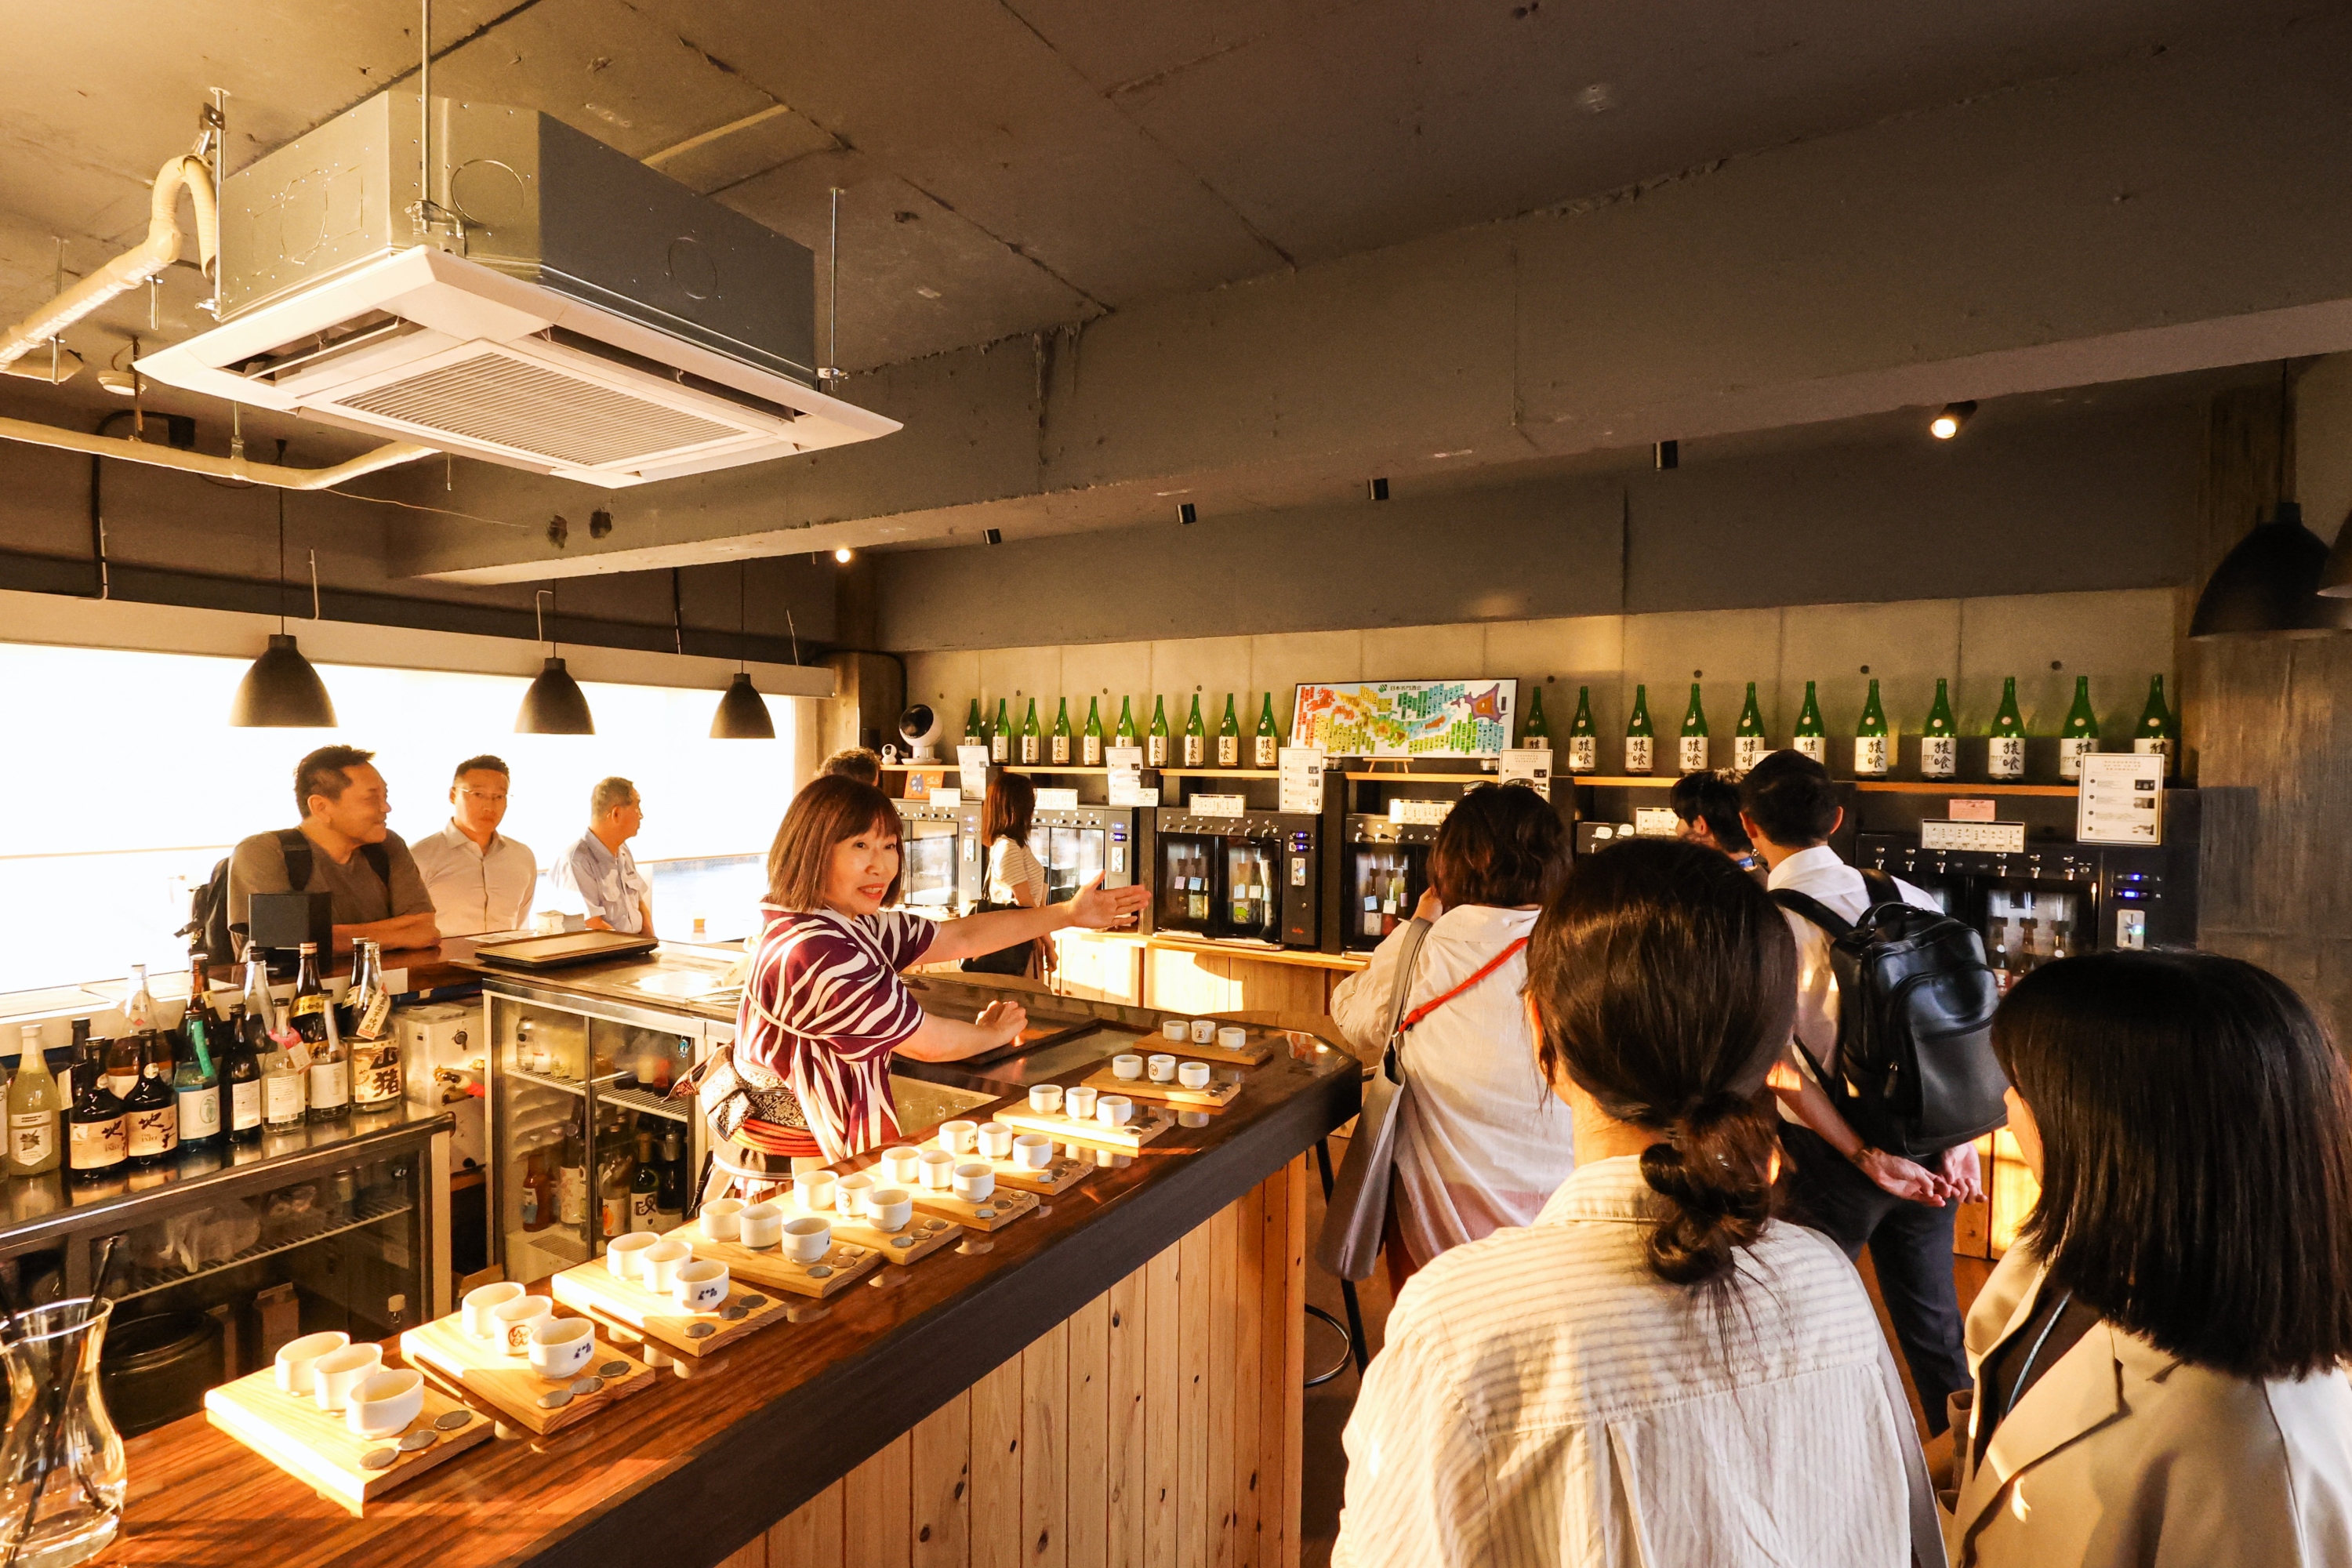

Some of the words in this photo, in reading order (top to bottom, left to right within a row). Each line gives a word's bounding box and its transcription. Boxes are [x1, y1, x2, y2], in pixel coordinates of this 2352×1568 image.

[1578, 739, 1592, 764] 猿喰
[1633, 739, 1648, 765] 猿喰
[1687, 739, 1702, 766] 猿喰
[1868, 739, 1884, 768] 猿喰
[1934, 740, 1951, 769] 猿喰
[2003, 740, 2020, 770] 猿喰
[369, 1047, 399, 1098] 山猪
